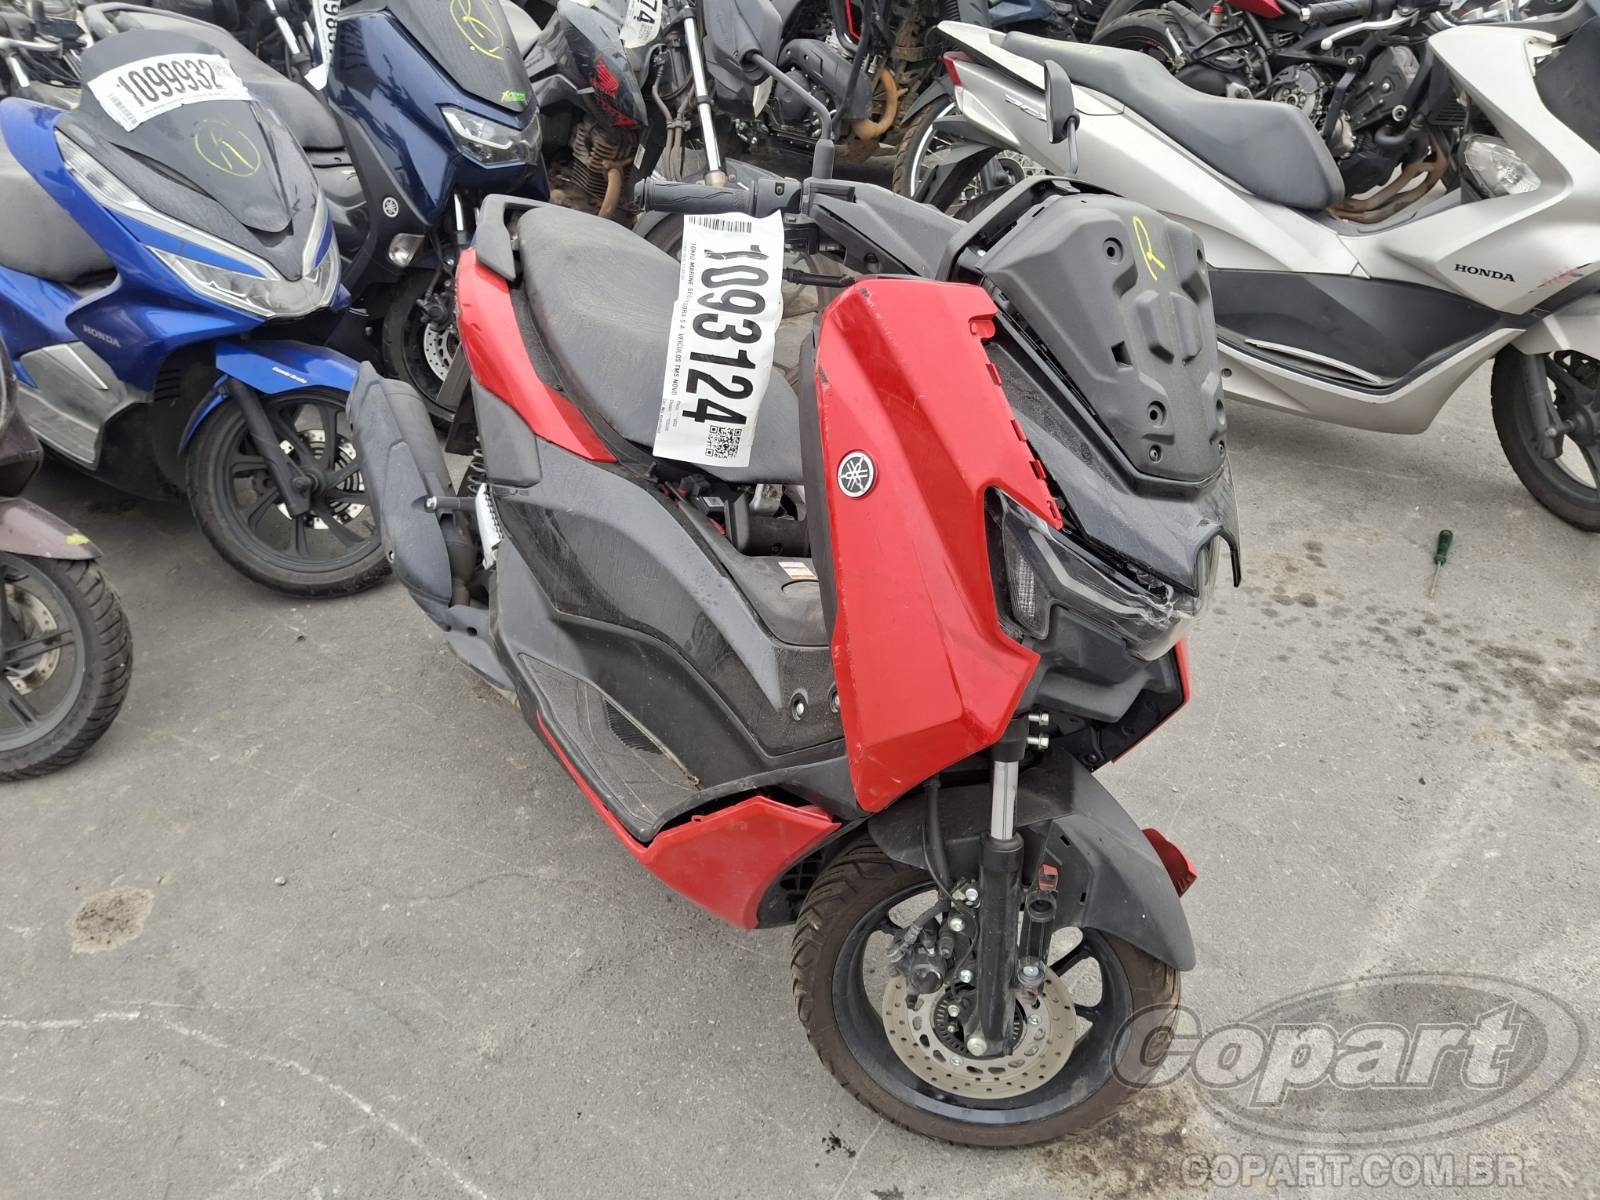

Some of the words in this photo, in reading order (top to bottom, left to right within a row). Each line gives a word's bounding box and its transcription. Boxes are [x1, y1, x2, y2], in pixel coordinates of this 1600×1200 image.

[115, 58, 226, 108] 1099932
[1454, 263, 1516, 283] HONDA
[82, 324, 122, 348] HONDA
[682, 244, 769, 425] 1093124
[671, 379, 679, 396] NOVO
